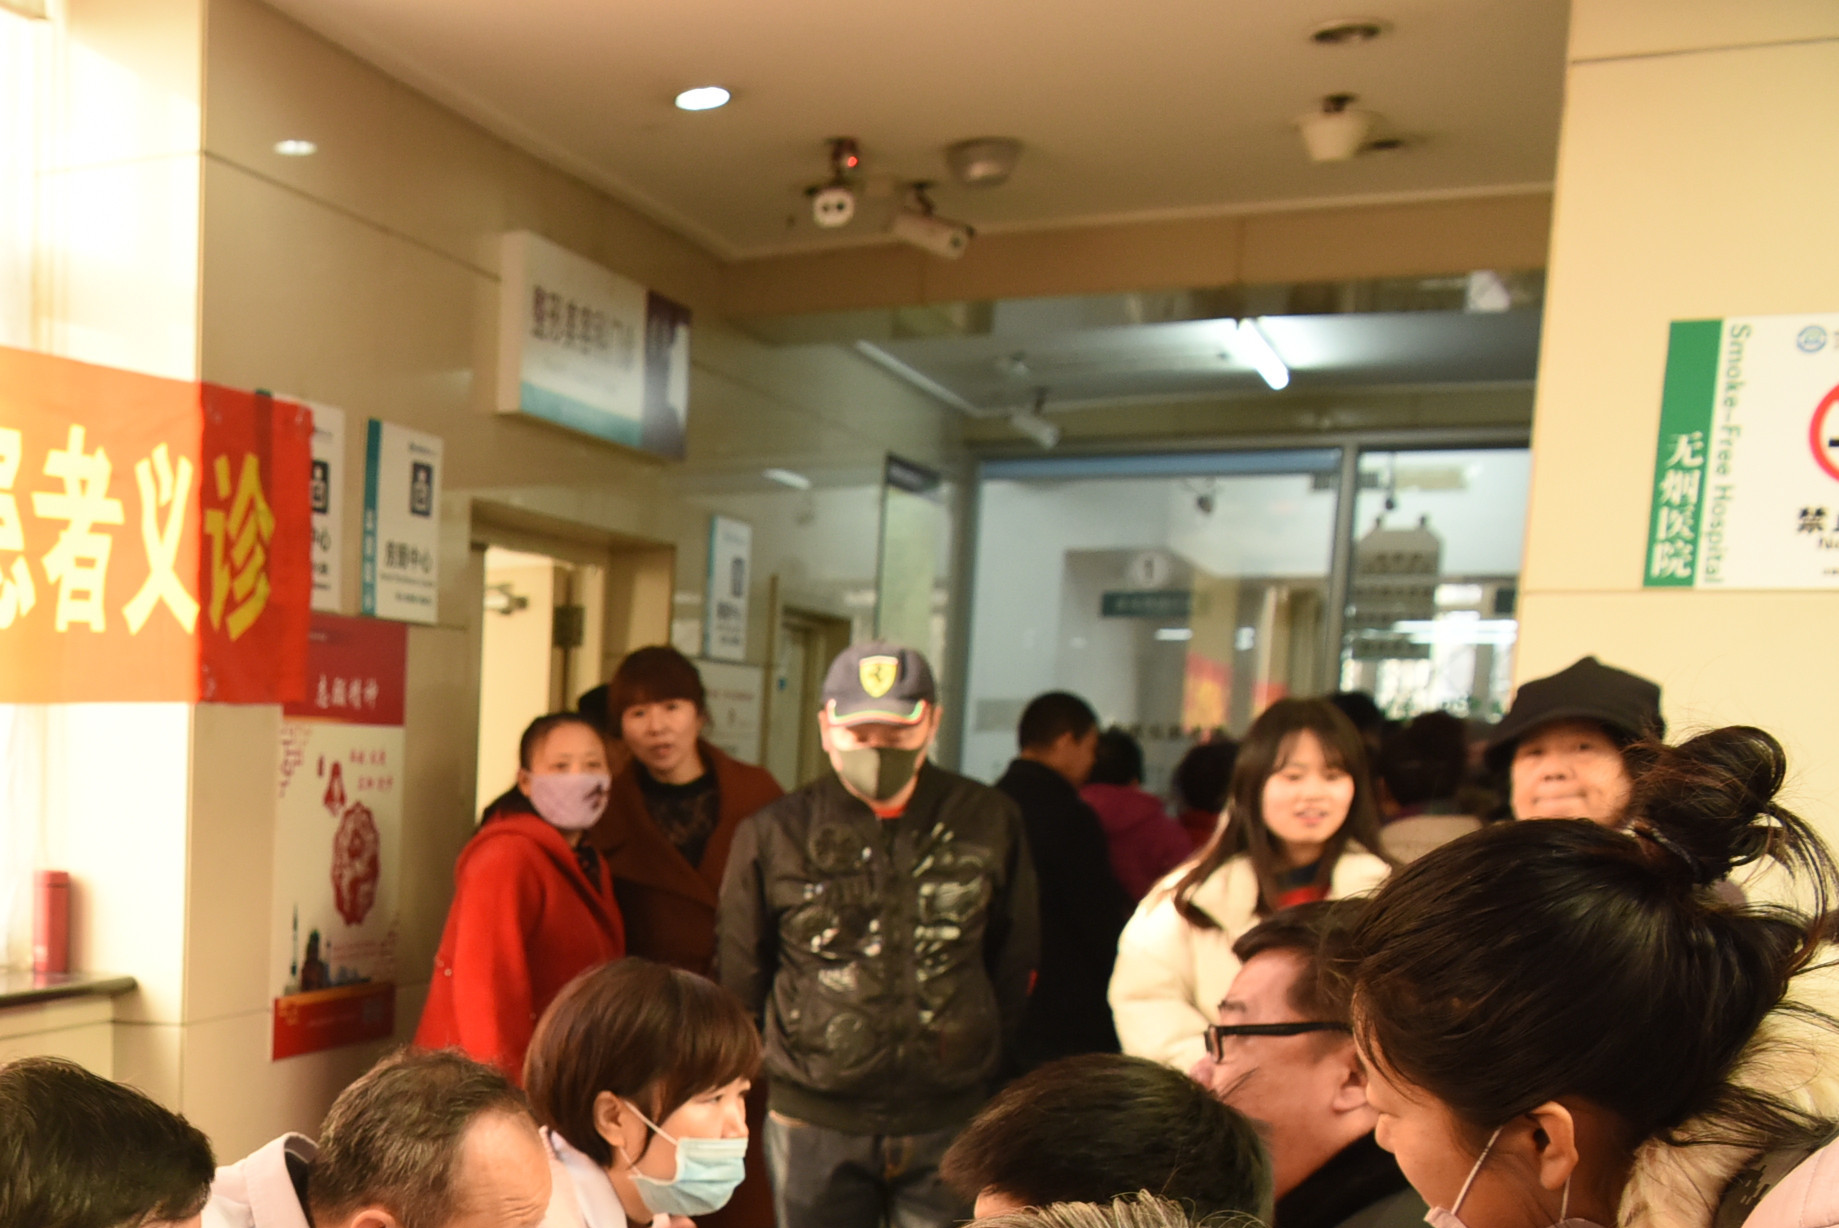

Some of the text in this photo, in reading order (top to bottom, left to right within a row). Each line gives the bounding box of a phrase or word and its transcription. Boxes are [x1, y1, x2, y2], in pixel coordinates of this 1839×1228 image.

[1650, 430, 1705, 579] 无烟医院
[1703, 323, 1752, 584] Smoke-Free Hospital
